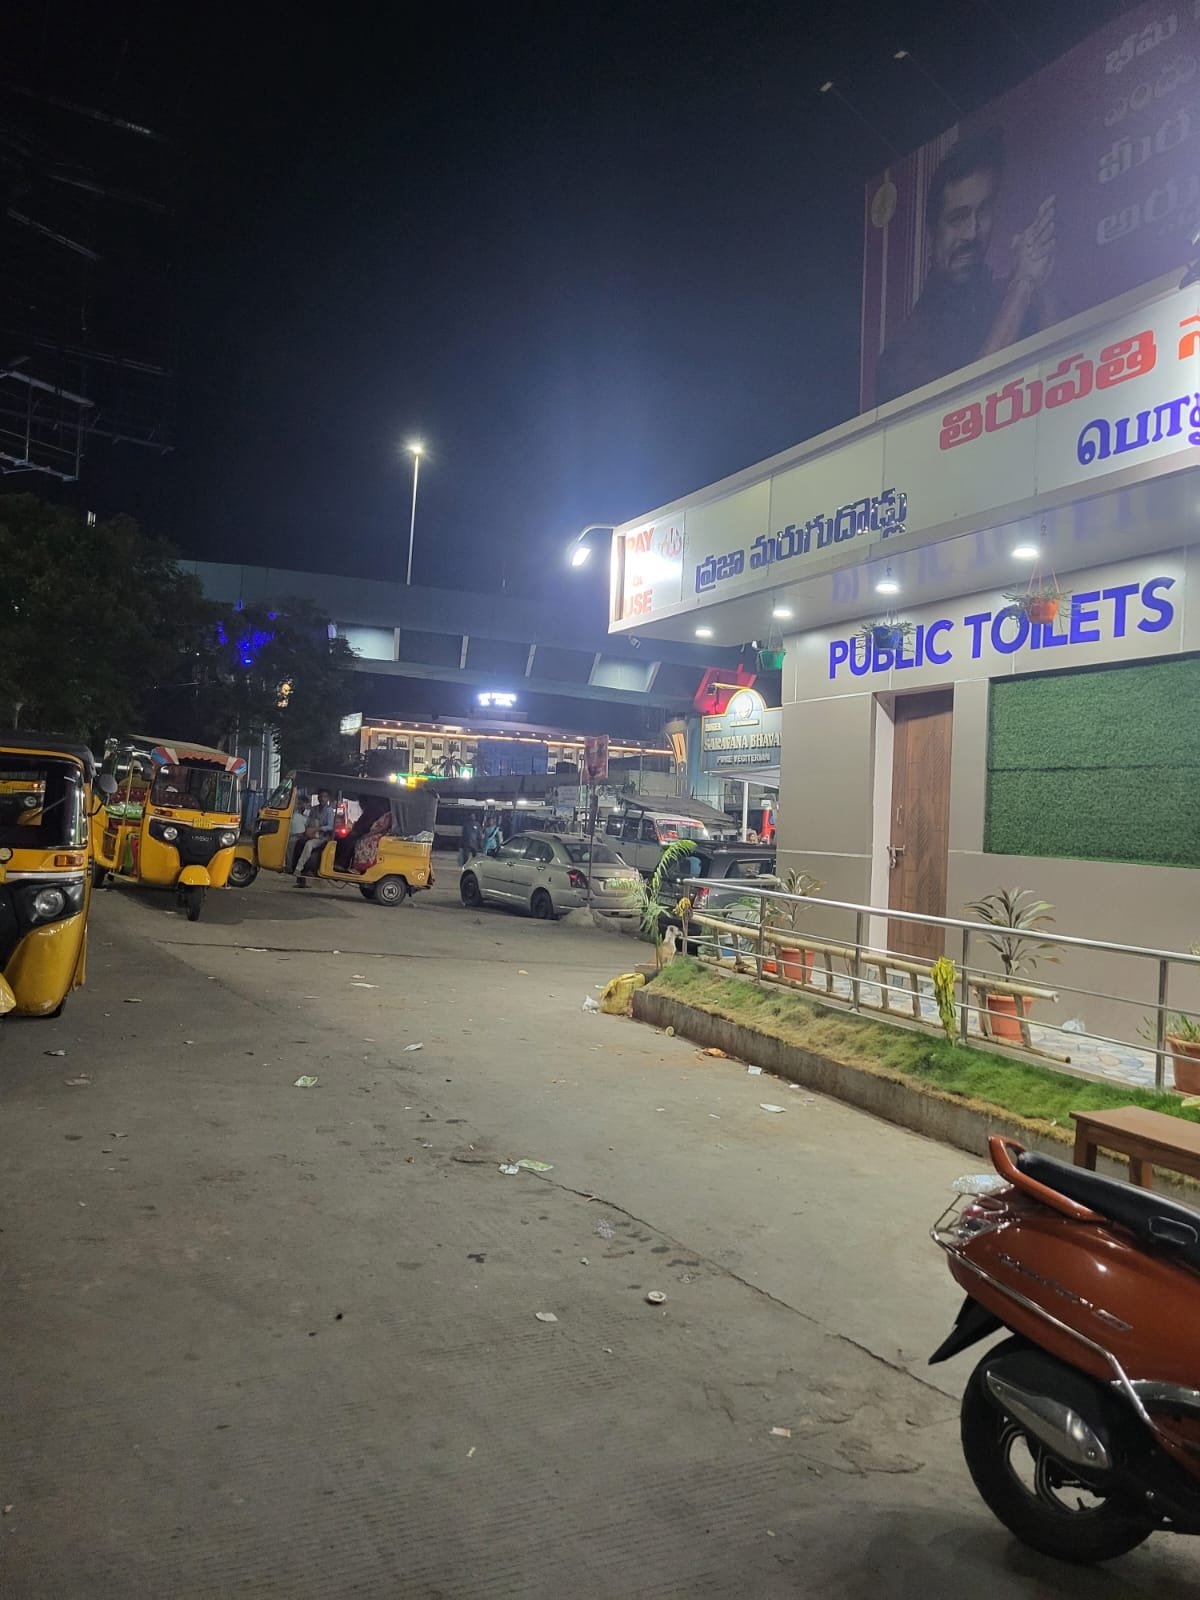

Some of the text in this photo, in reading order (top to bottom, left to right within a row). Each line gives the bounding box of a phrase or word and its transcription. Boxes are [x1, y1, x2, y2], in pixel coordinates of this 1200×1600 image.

[939, 330, 1157, 450] తిరుపతి
[626, 526, 655, 553] PAY
[695, 549, 745, 594] ప్రజా
[623, 588, 653, 618] USE
[829, 619, 954, 679] PUBLIC
